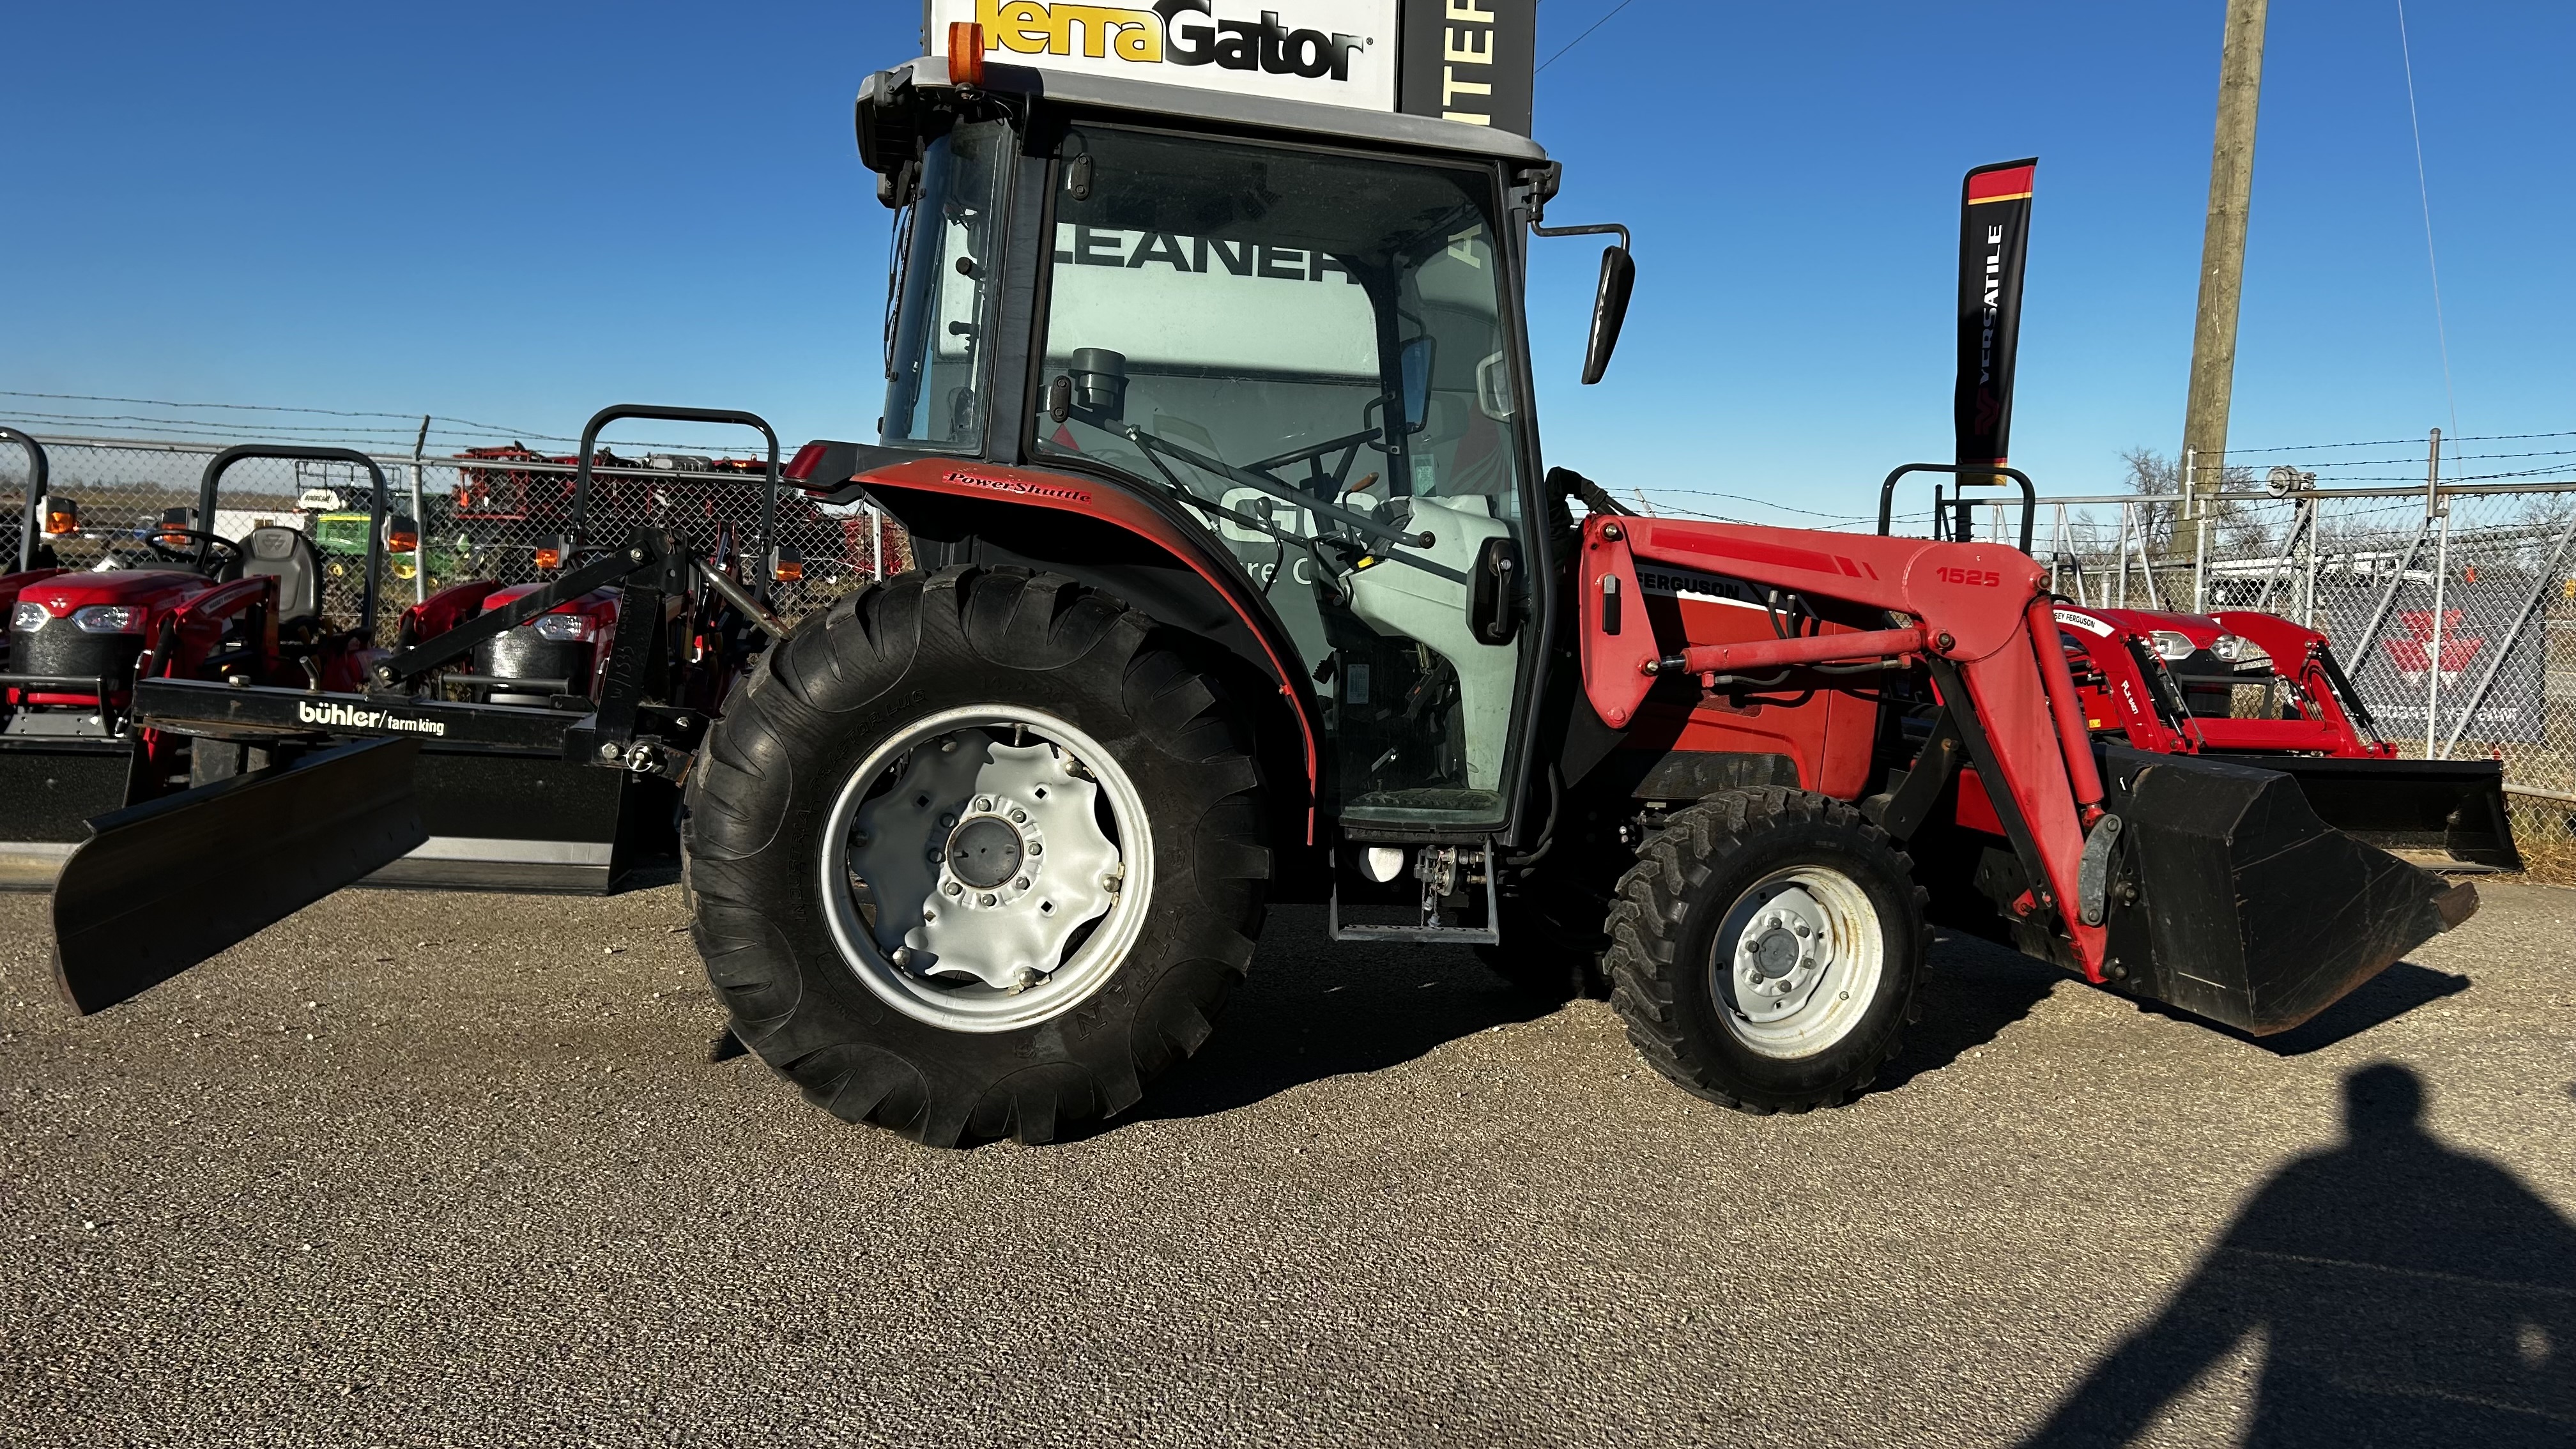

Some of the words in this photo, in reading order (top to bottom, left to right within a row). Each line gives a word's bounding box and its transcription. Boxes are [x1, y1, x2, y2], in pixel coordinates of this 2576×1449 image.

[1979, 224, 2004, 385] VERSATILE
[947, 470, 1092, 503] PowerShuttle
[1936, 566, 2000, 588] 1525
[2066, 613, 2096, 629] FERGUSON
[388, 715, 417, 732] farm
[418, 717, 445, 737] king
[1076, 904, 1184, 1043] TITAN
